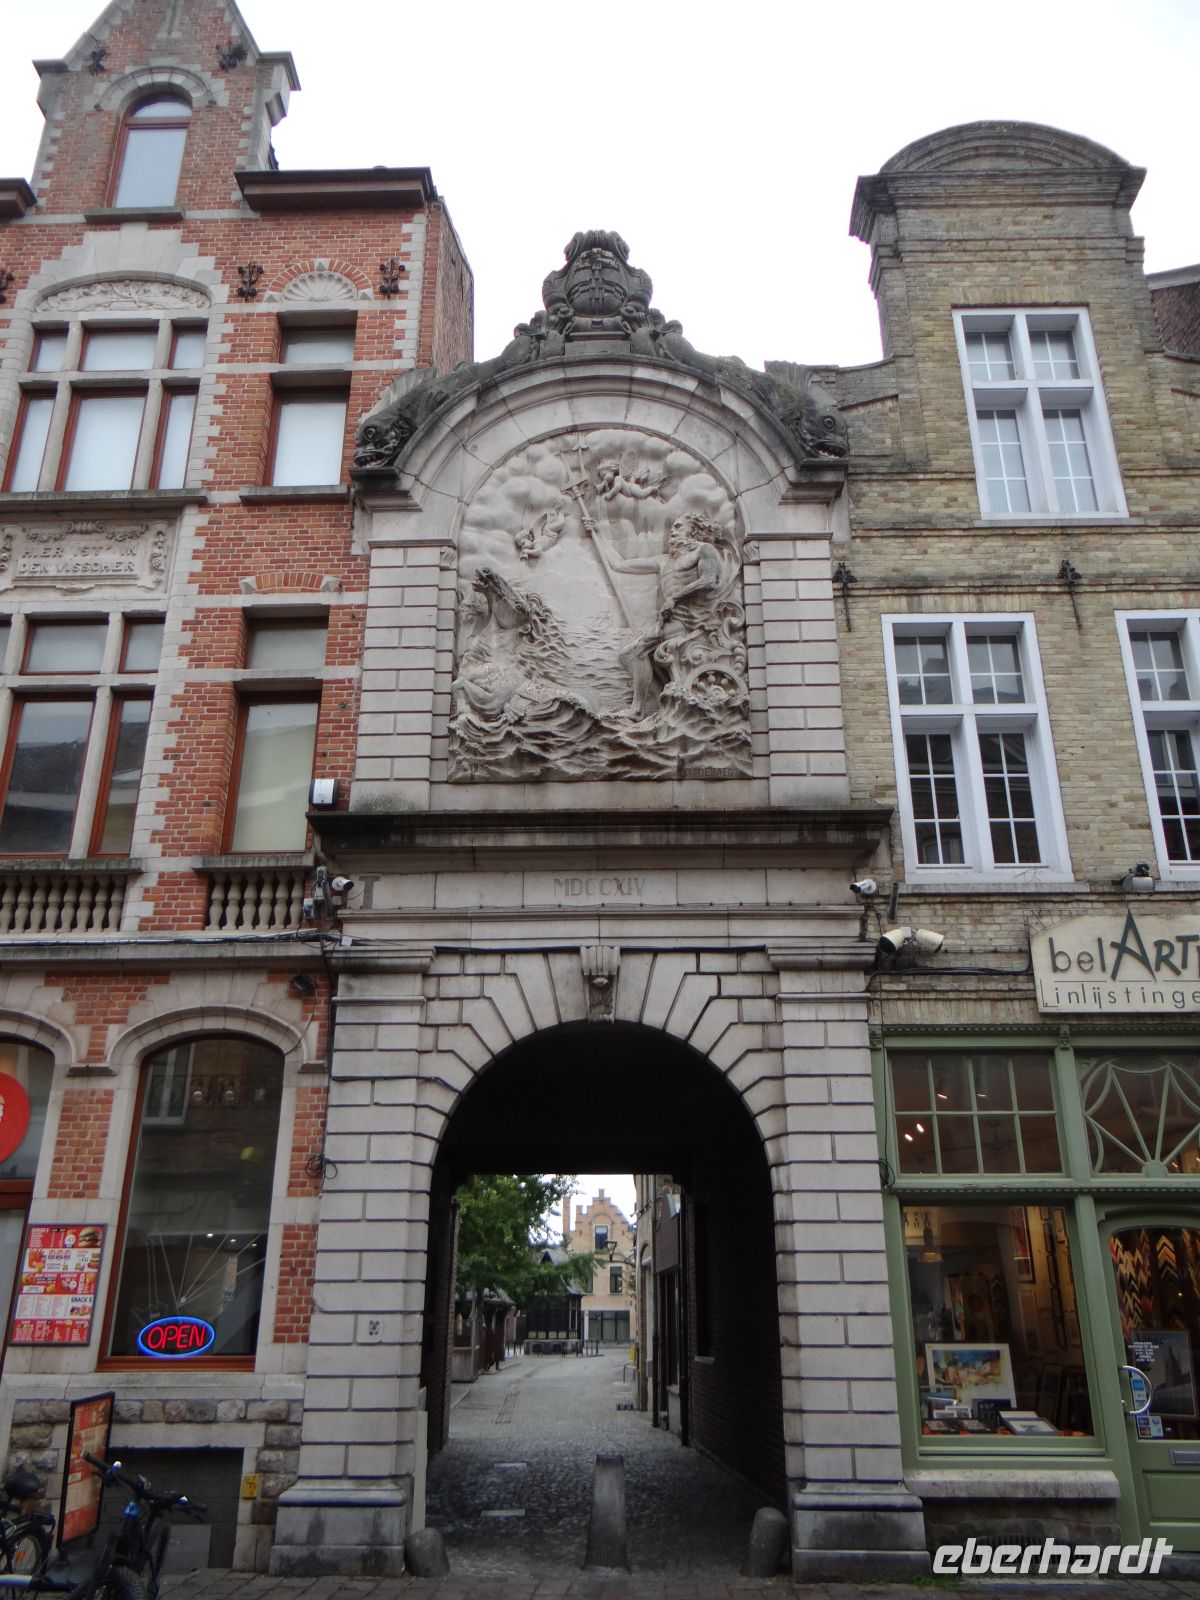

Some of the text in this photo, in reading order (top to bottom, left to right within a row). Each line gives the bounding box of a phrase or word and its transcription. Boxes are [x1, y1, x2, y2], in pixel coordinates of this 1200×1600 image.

[19, 561, 135, 574] DEN VISSCHER
[553, 877, 646, 897] MDCCXIV
[1049, 904, 1200, 984] belART
[147, 1324, 207, 1350] OPEN
